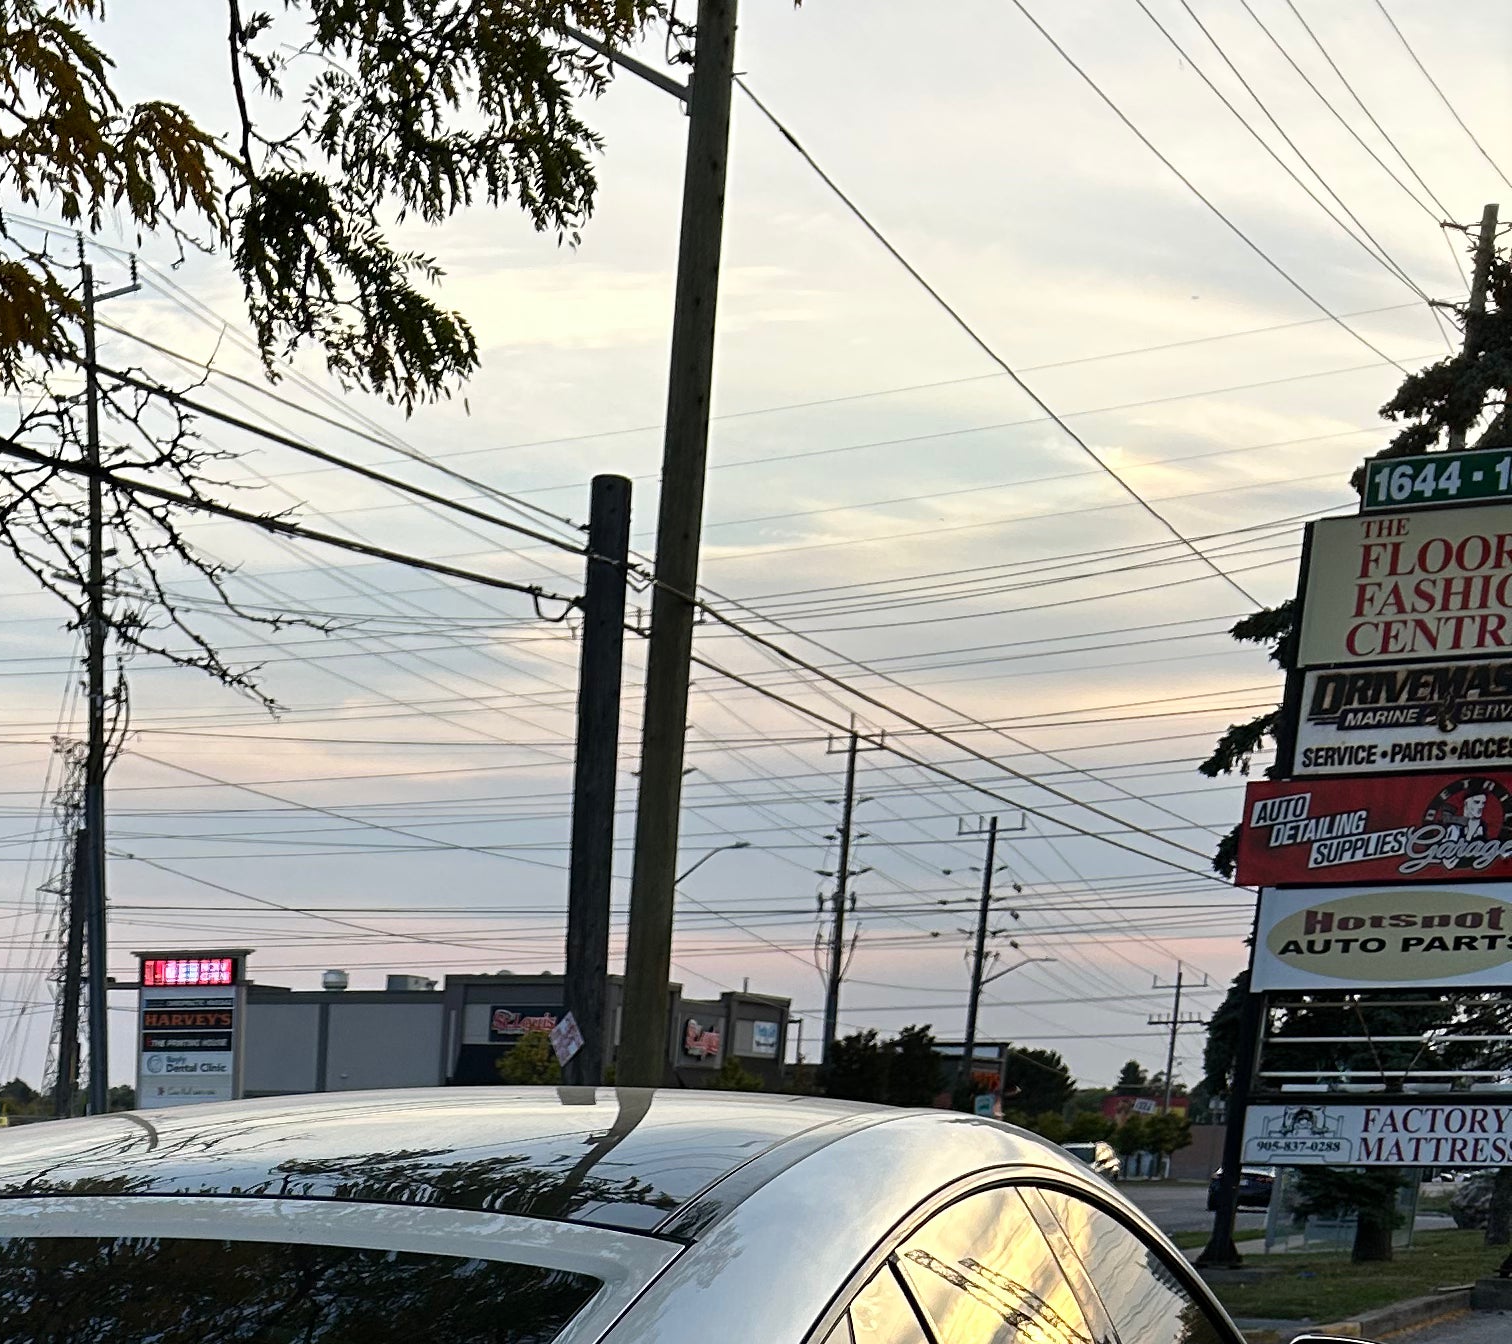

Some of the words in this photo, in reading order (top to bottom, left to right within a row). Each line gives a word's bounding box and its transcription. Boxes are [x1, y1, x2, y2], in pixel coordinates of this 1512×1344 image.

[1375, 460, 1462, 501] 1644
[1361, 517, 1411, 539] THE
[1345, 613, 1512, 657] CENTR
[1344, 708, 1420, 727] MARINE
[1460, 703, 1512, 721] SERV
[1302, 744, 1378, 768] SERVICE
[1390, 740, 1448, 763] PARTS
[1457, 736, 1512, 760] ACCE
[1255, 796, 1307, 825] AUTO
[1269, 810, 1368, 848] DETAILING
[1313, 830, 1406, 865] SUPPLIES
[1278, 938, 1387, 955] AUTO
[144, 1013, 232, 1026] HARVEY'S
[165, 1062, 198, 1073] Dental
[199, 1062, 228, 1073] Clinic
[1361, 1107, 1512, 1134] FACTORY
[1256, 1140, 1341, 1153] 905-837-0288
[1356, 1137, 1512, 1163] MATTRES
